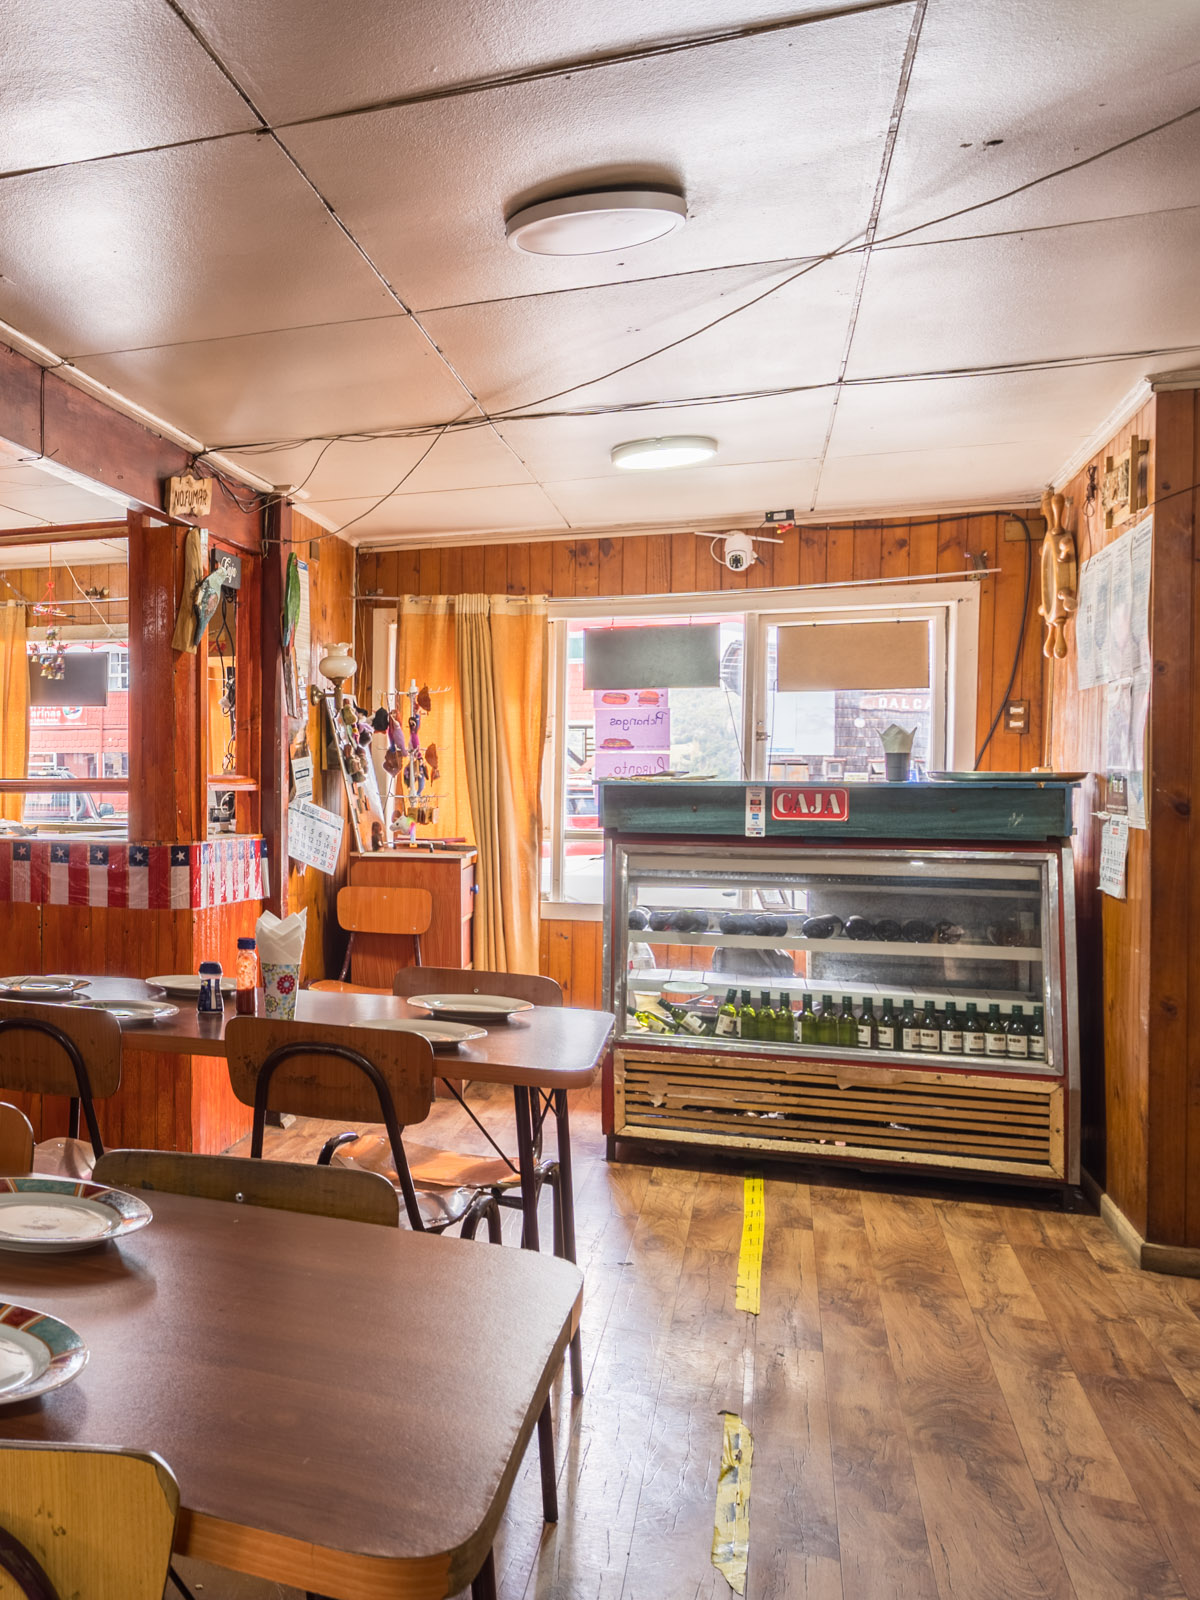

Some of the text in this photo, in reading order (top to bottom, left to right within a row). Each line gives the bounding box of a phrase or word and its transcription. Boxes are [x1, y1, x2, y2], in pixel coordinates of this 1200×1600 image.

[184, 488, 208, 506] FUMAR
[31, 710, 61, 719] arinas
[776, 792, 841, 814] CAJA
